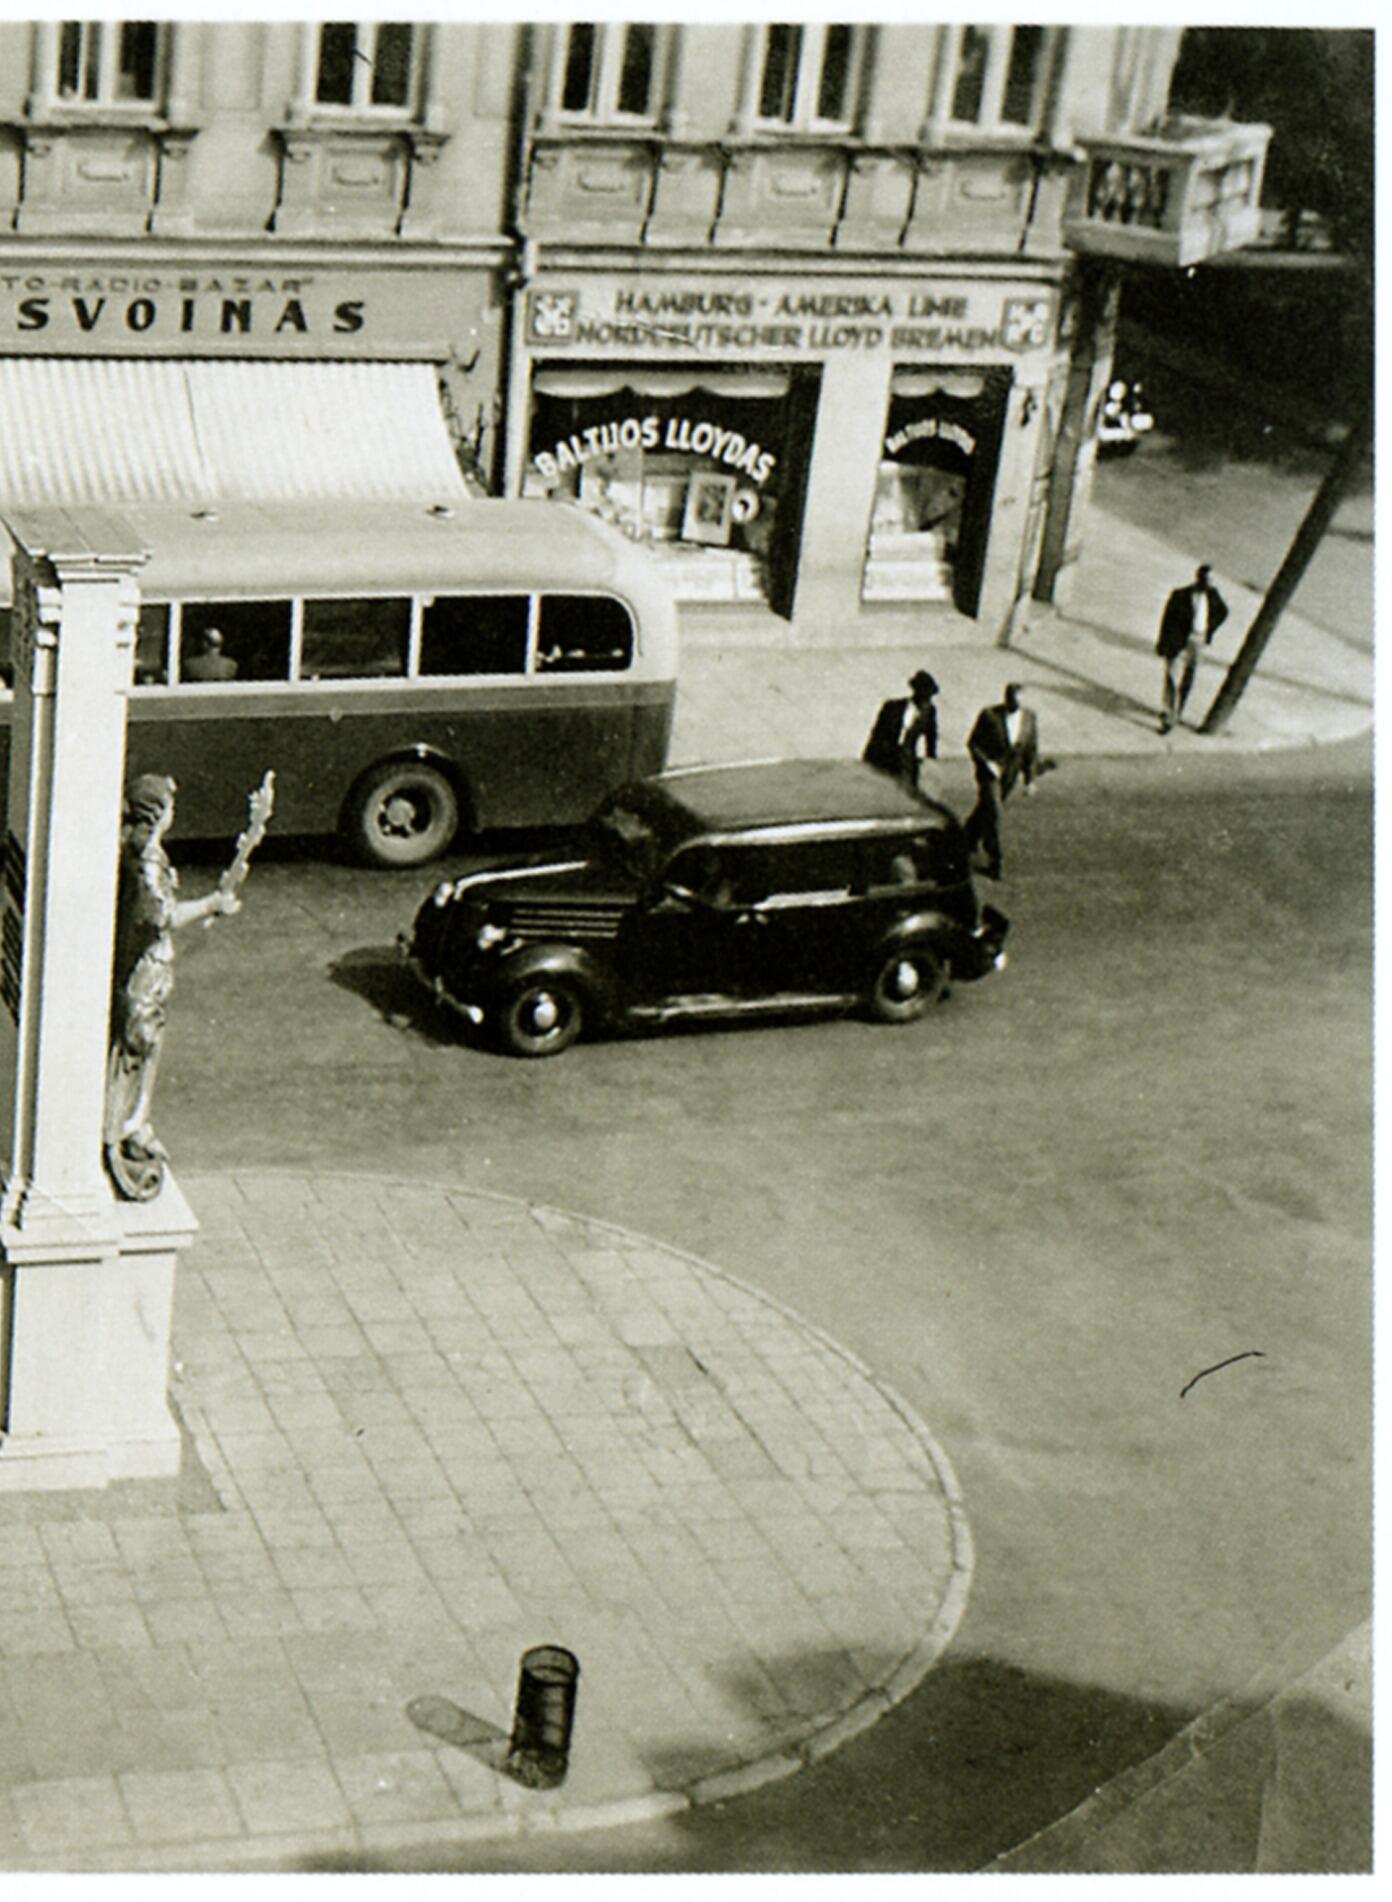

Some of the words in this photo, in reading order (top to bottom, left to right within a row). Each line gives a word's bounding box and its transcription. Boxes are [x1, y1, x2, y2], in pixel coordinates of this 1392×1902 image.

[615, 289, 753, 316] HAMBURG
[775, 293, 892, 318] AMERIKA
[809, 324, 884, 350] LLOYD
[890, 326, 999, 351] BREMEN
[534, 416, 659, 477] BALTIJOS
[665, 418, 776, 482] LLOYDAS
